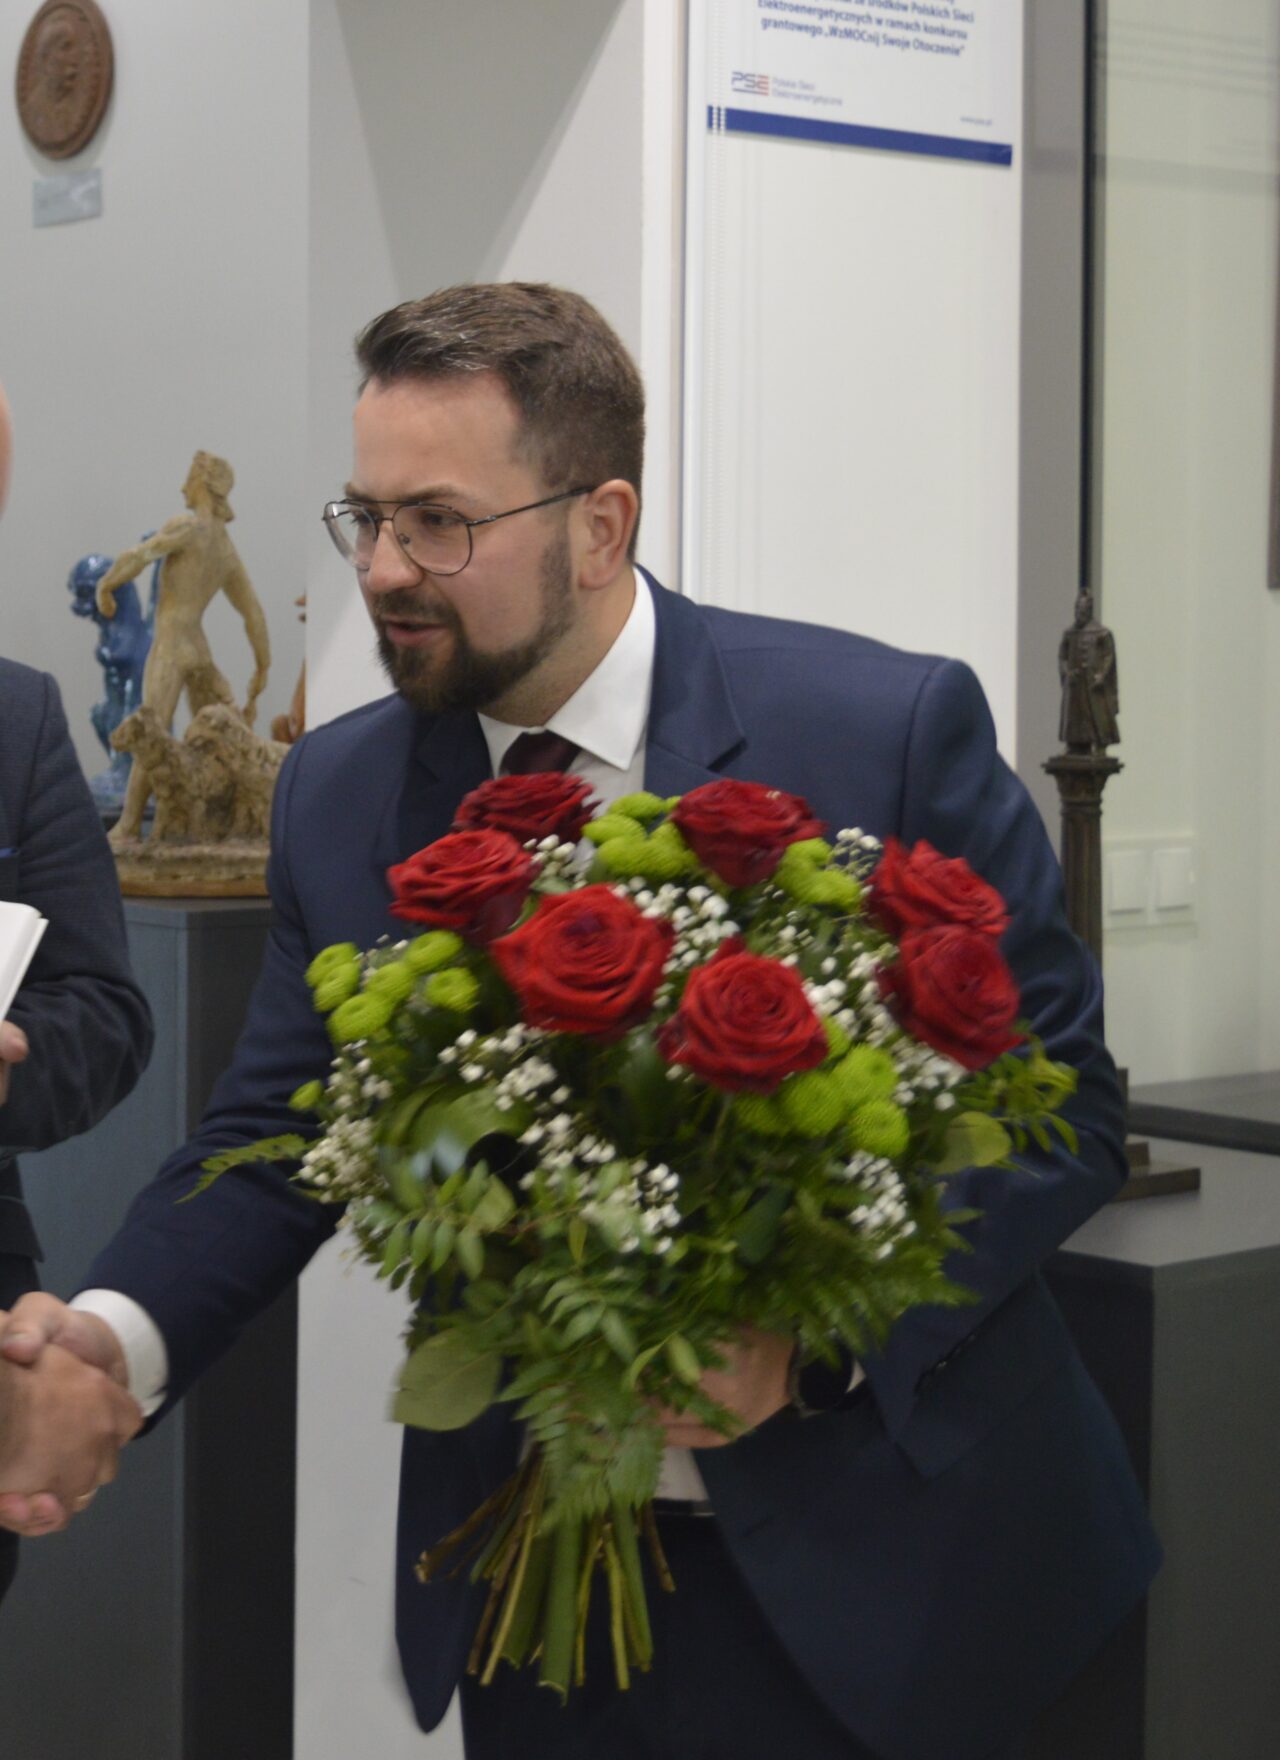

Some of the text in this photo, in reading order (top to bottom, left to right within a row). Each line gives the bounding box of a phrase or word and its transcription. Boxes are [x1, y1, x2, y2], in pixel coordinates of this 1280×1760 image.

[758, 0, 873, 24] Elektroenergetycznych
[885, 17, 921, 32] ramach
[922, 22, 968, 40] konkursu
[911, 1, 950, 18] Polskich
[952, 8, 975, 23] Sieci
[761, 17, 823, 37] grantowego
[882, 33, 911, 50] Swoje
